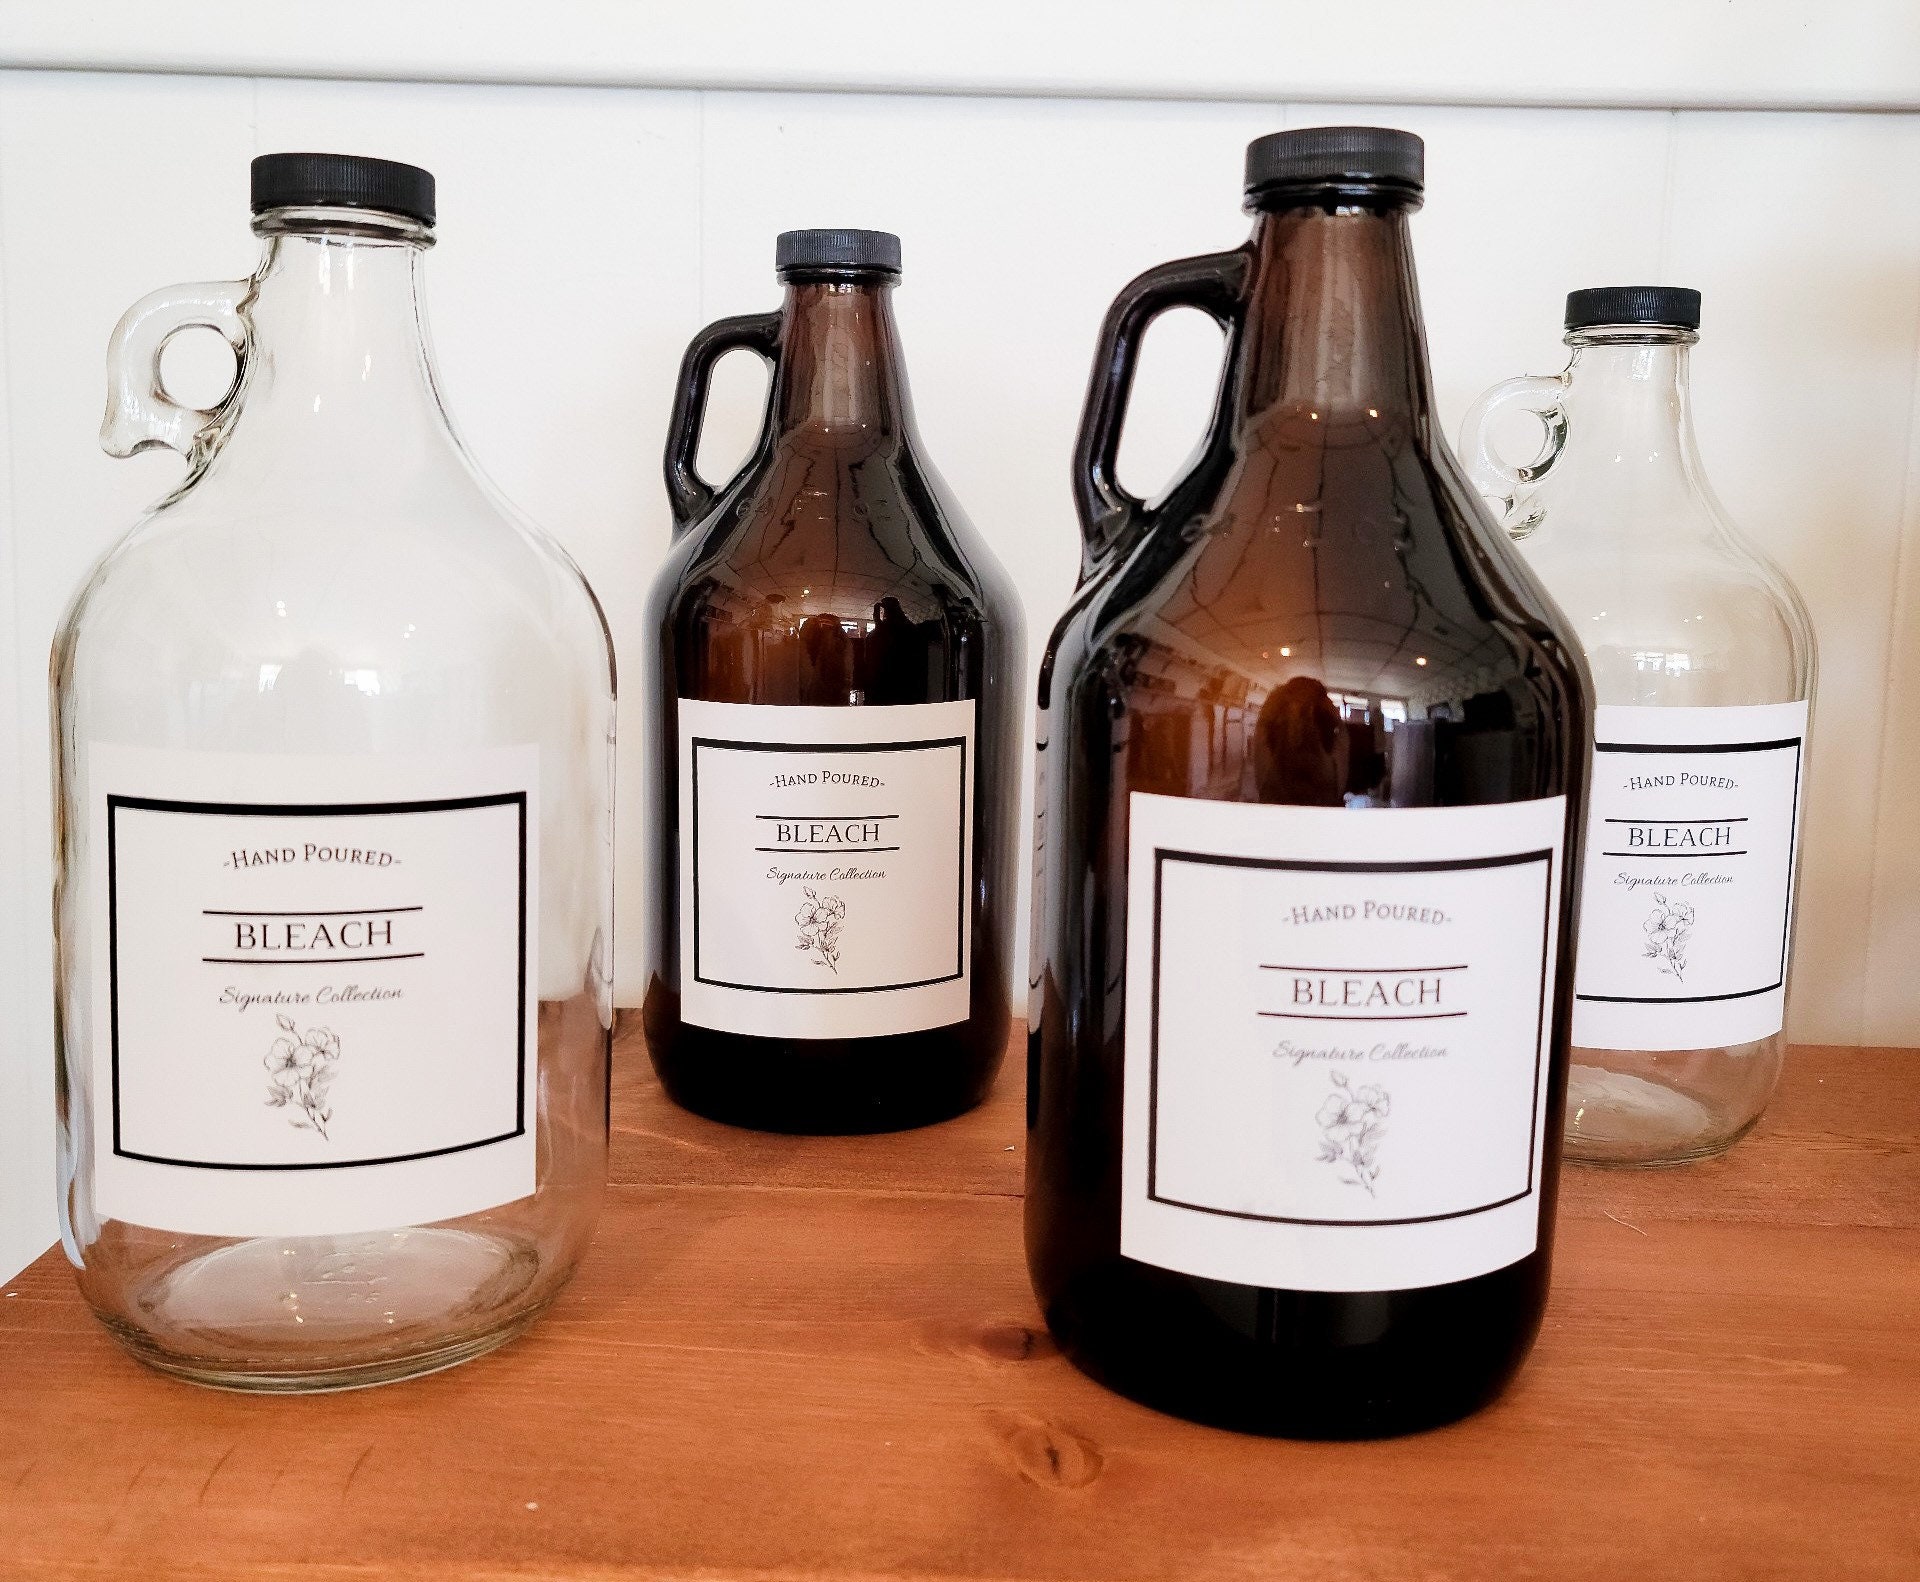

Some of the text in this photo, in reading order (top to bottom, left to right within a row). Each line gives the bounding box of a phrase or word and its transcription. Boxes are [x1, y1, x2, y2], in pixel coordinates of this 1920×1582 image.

[776, 823, 880, 843] BLEACH
[1628, 826, 1731, 847] BLEACH
[766, 866, 887, 886] Signature Collection
[1613, 872, 1734, 891] Signature Collection
[235, 919, 393, 950] BLEACH
[219, 983, 404, 1013] Signature Collection
[1292, 977, 1442, 1007] BLEACH
[1272, 1039, 1448, 1067] Signature Collection
